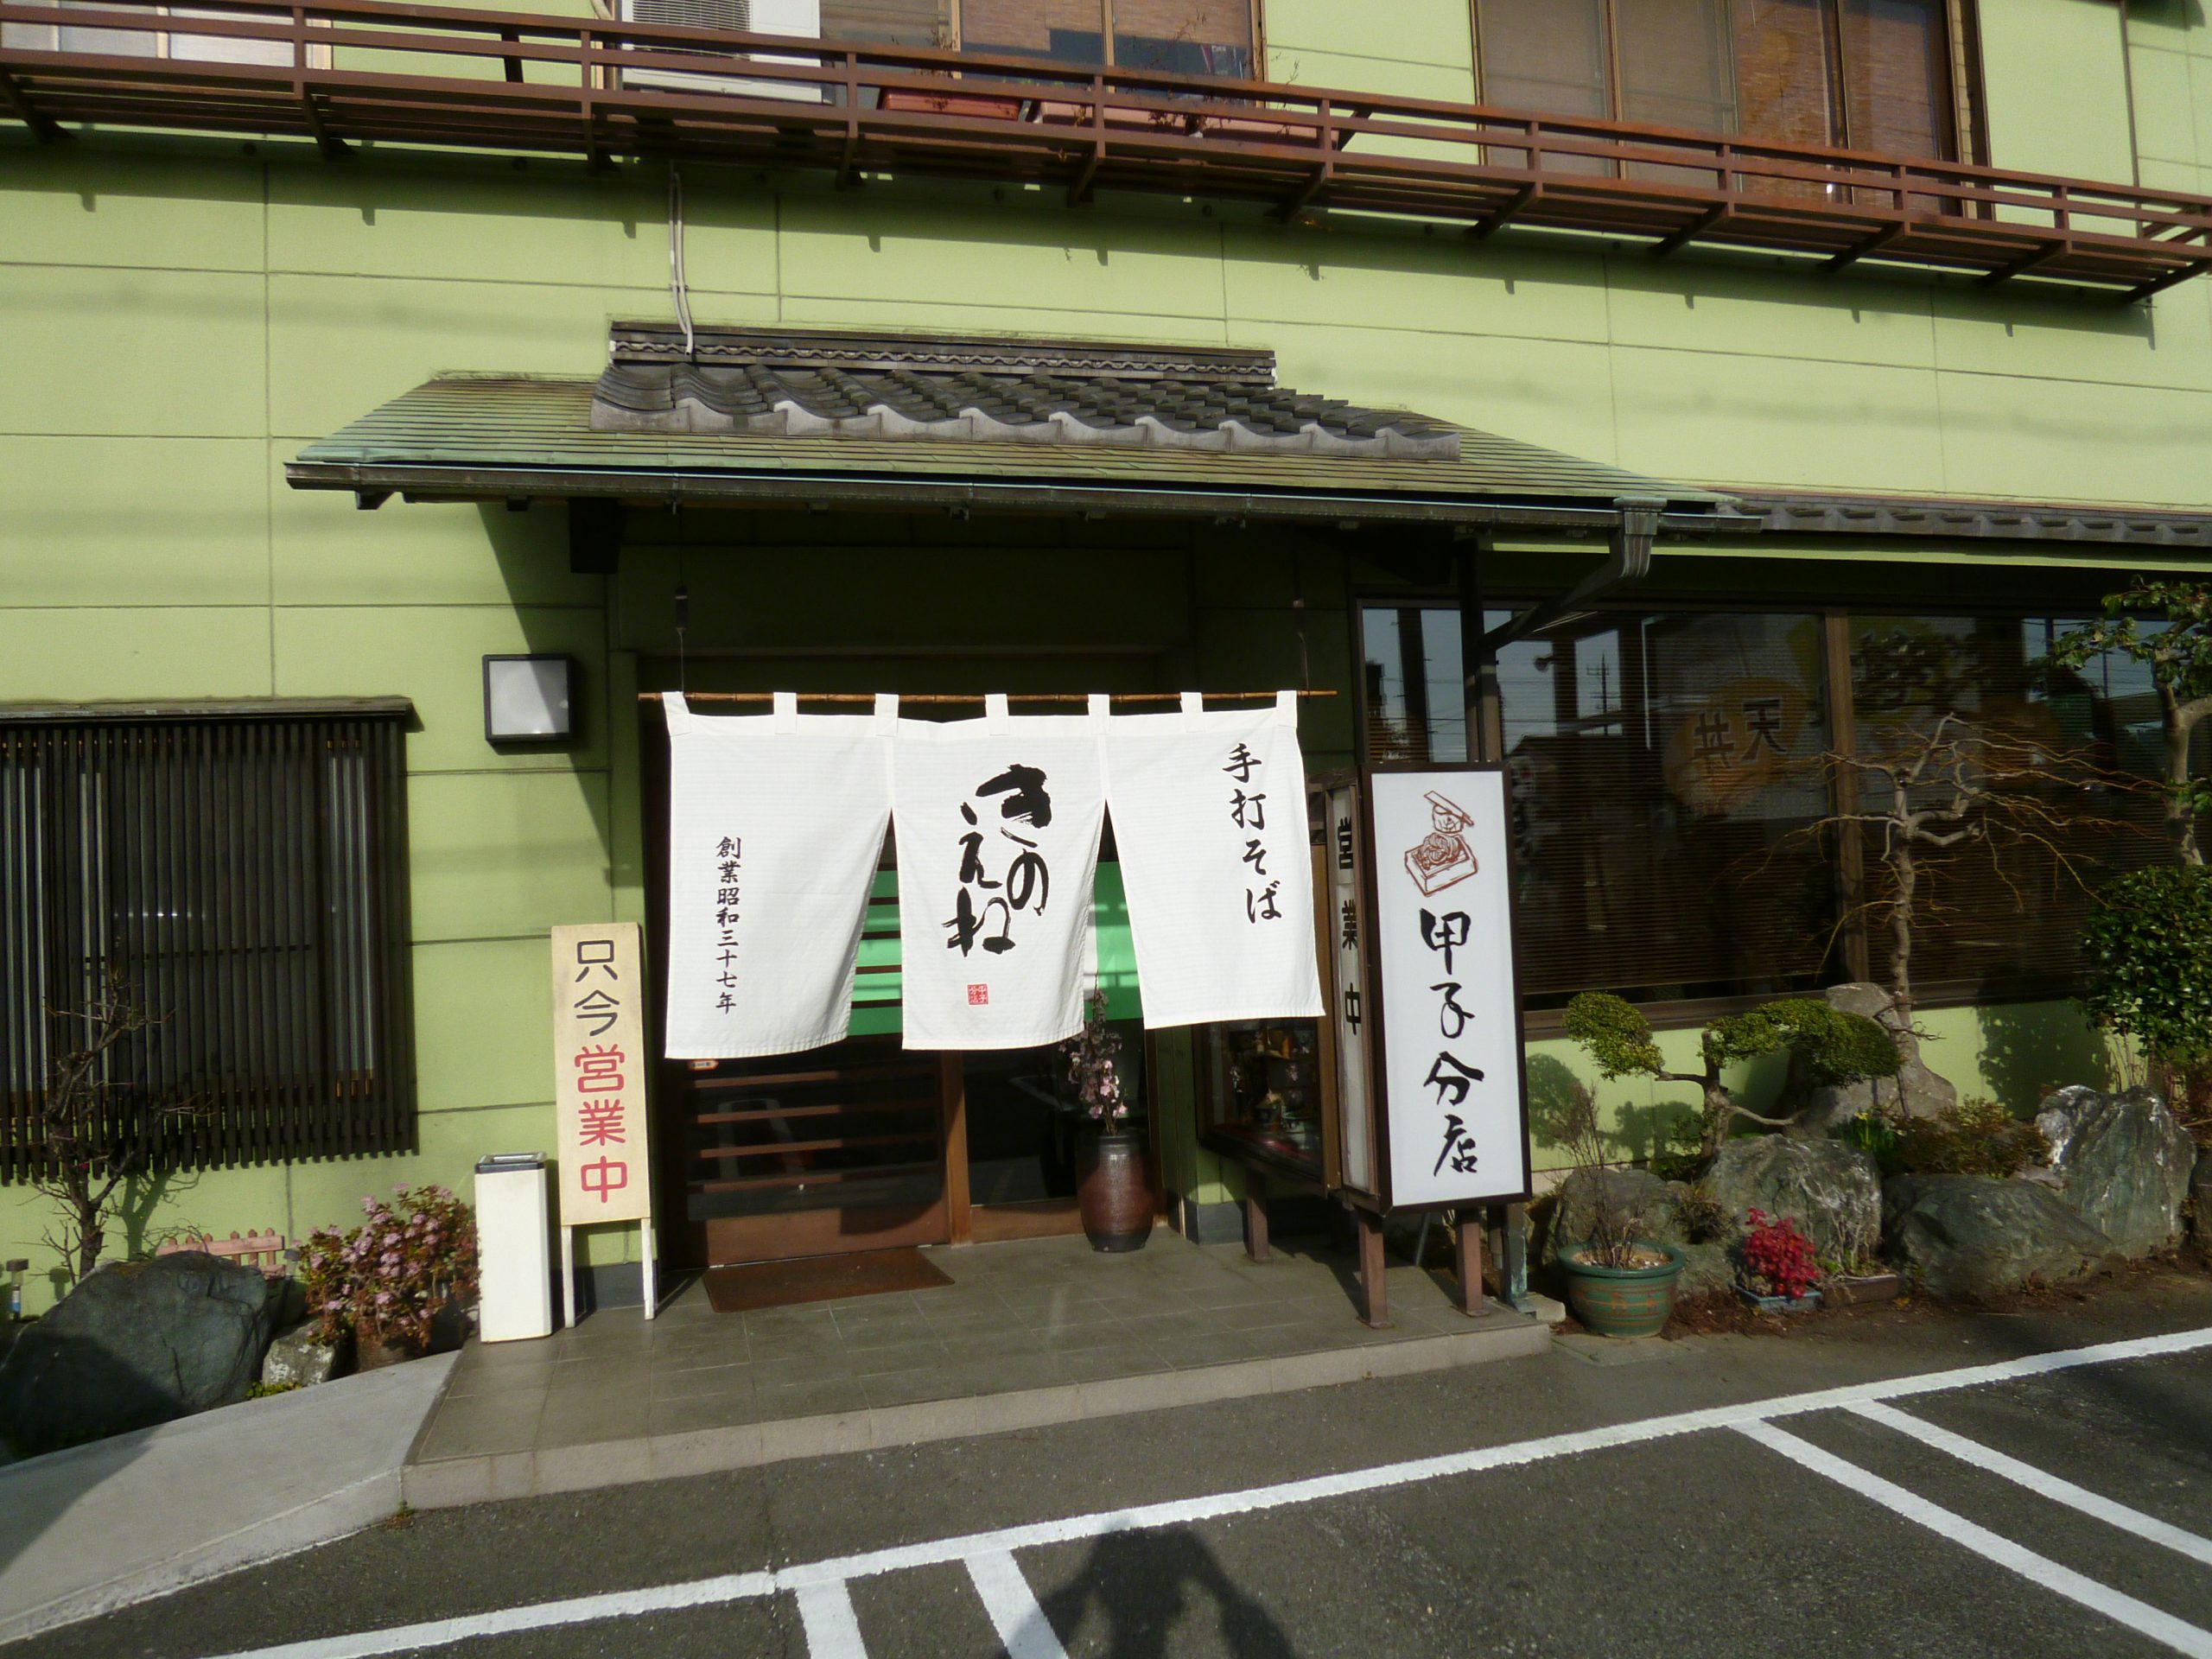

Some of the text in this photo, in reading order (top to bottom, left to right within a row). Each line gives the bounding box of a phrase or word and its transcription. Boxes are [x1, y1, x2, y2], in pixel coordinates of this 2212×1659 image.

[715, 836, 741, 1014] 創業昭和三十七年
[1223, 743, 1282, 924] 手打そば
[1338, 817, 1361, 1035] 営業中
[575, 940, 628, 1203] 只今営業中
[1420, 907, 1484, 1177] 甲子分店
